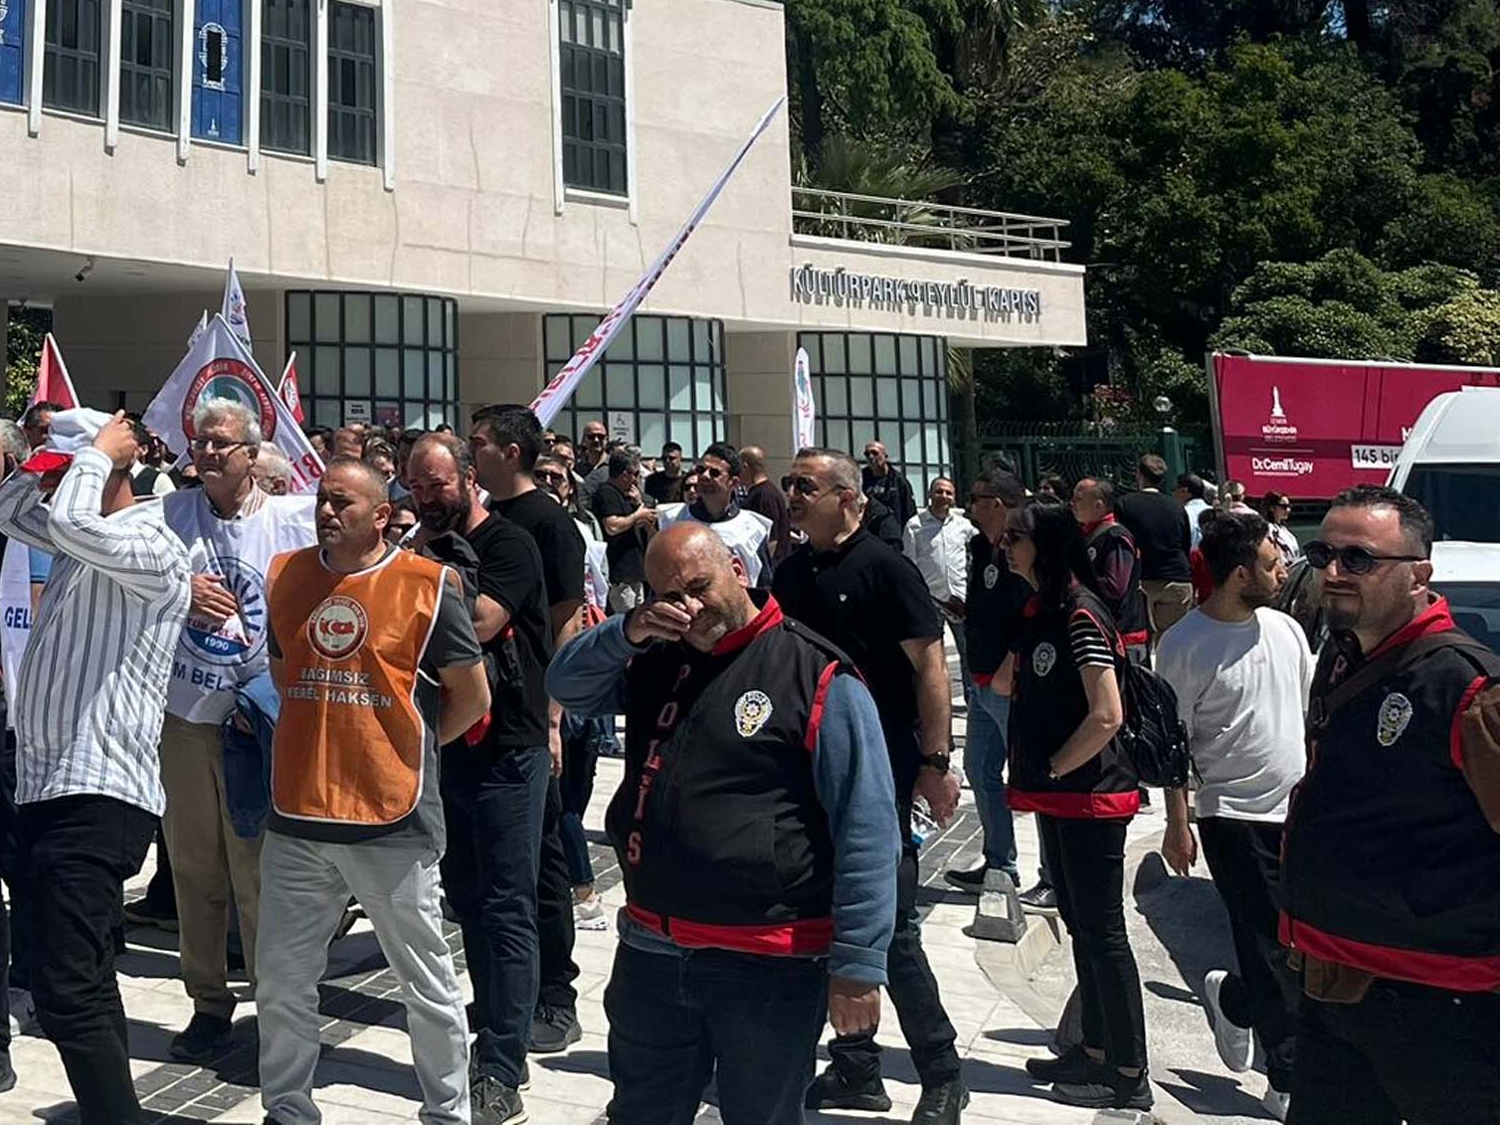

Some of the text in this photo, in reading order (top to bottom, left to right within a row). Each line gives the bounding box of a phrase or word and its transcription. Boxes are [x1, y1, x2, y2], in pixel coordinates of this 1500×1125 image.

[790, 263, 905, 304] KÜLTÜRPARK
[908, 281, 923, 306] 9
[925, 278, 983, 312] EYLÜL
[1354, 447, 1378, 464] 145
[4, 605, 32, 630] GEL
[203, 636, 230, 652] 1990
[191, 667, 247, 692] BEL-S
[324, 688, 393, 709] HAKSEN
